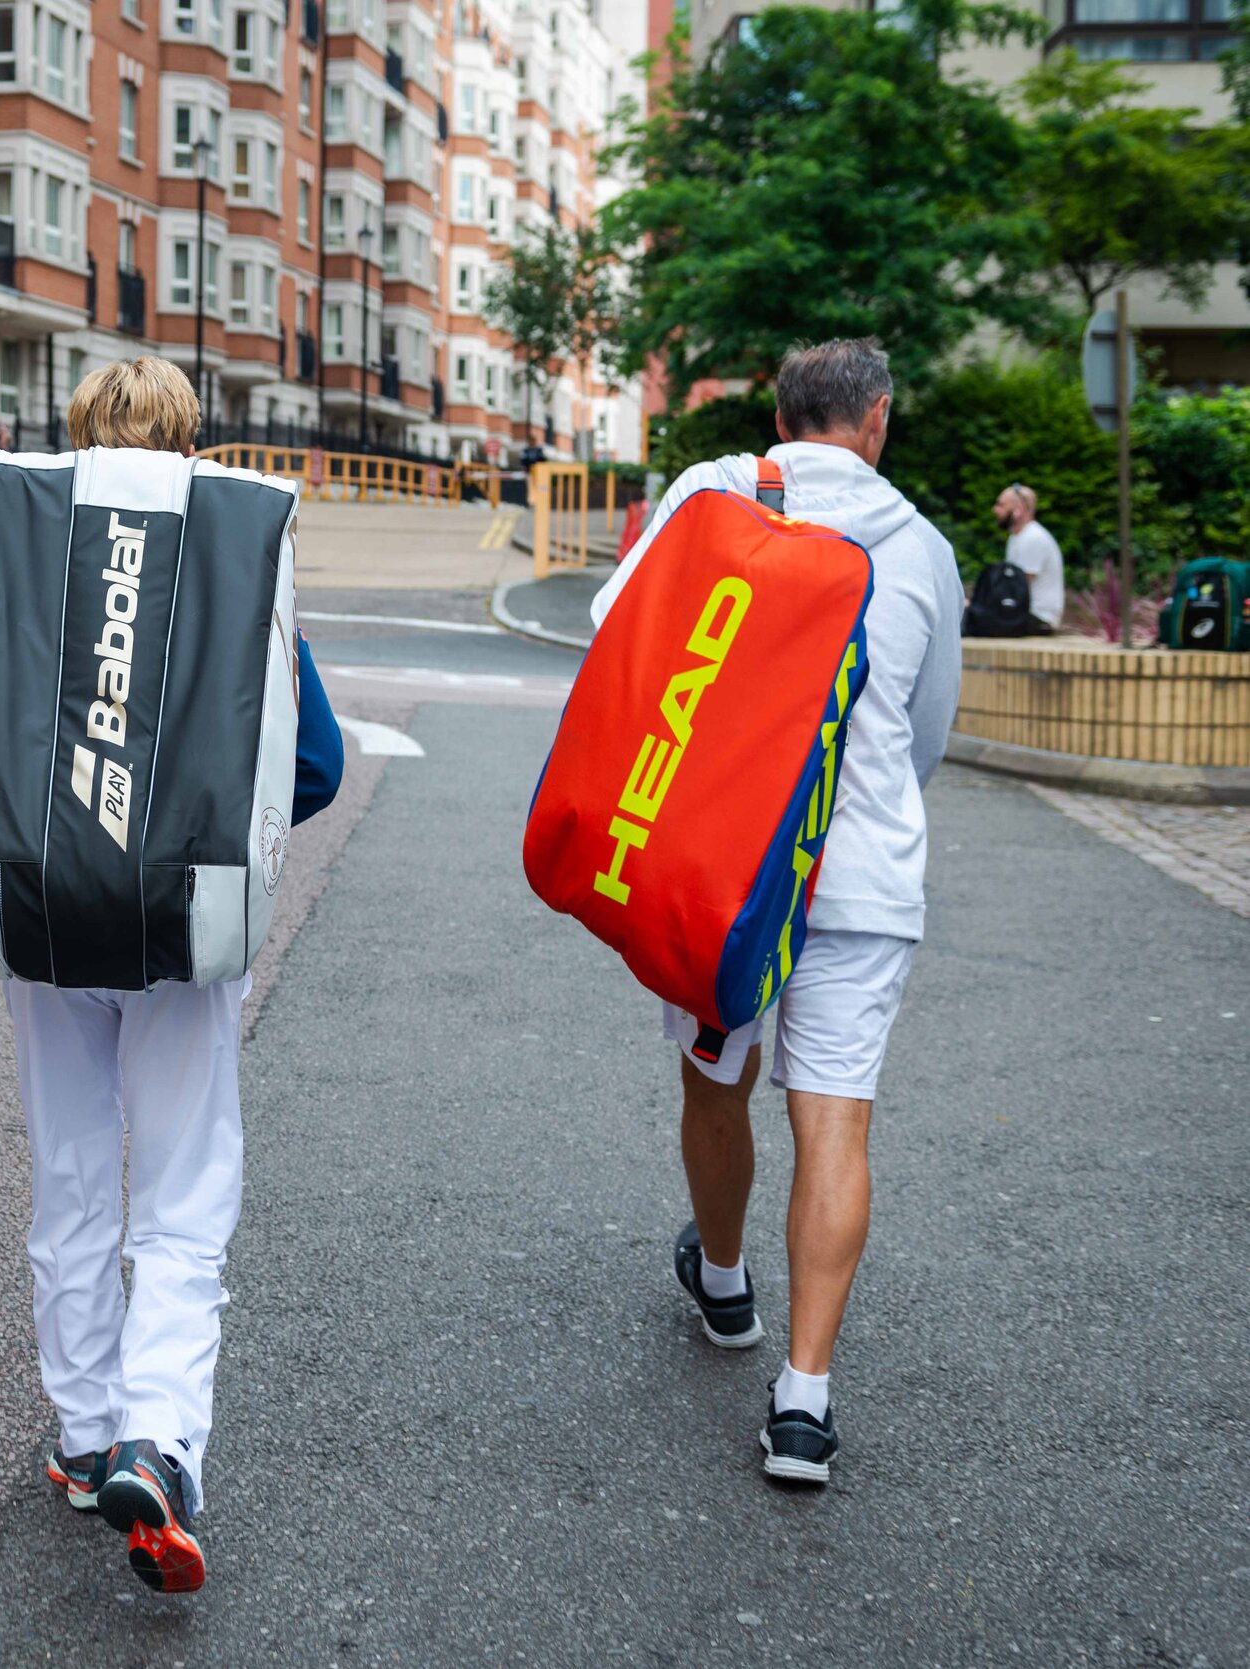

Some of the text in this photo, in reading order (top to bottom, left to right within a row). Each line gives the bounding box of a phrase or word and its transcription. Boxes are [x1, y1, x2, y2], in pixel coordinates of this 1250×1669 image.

[87, 512, 146, 747] Babolat
[594, 577, 752, 905] HEAD
[105, 768, 126, 821] PLAY
